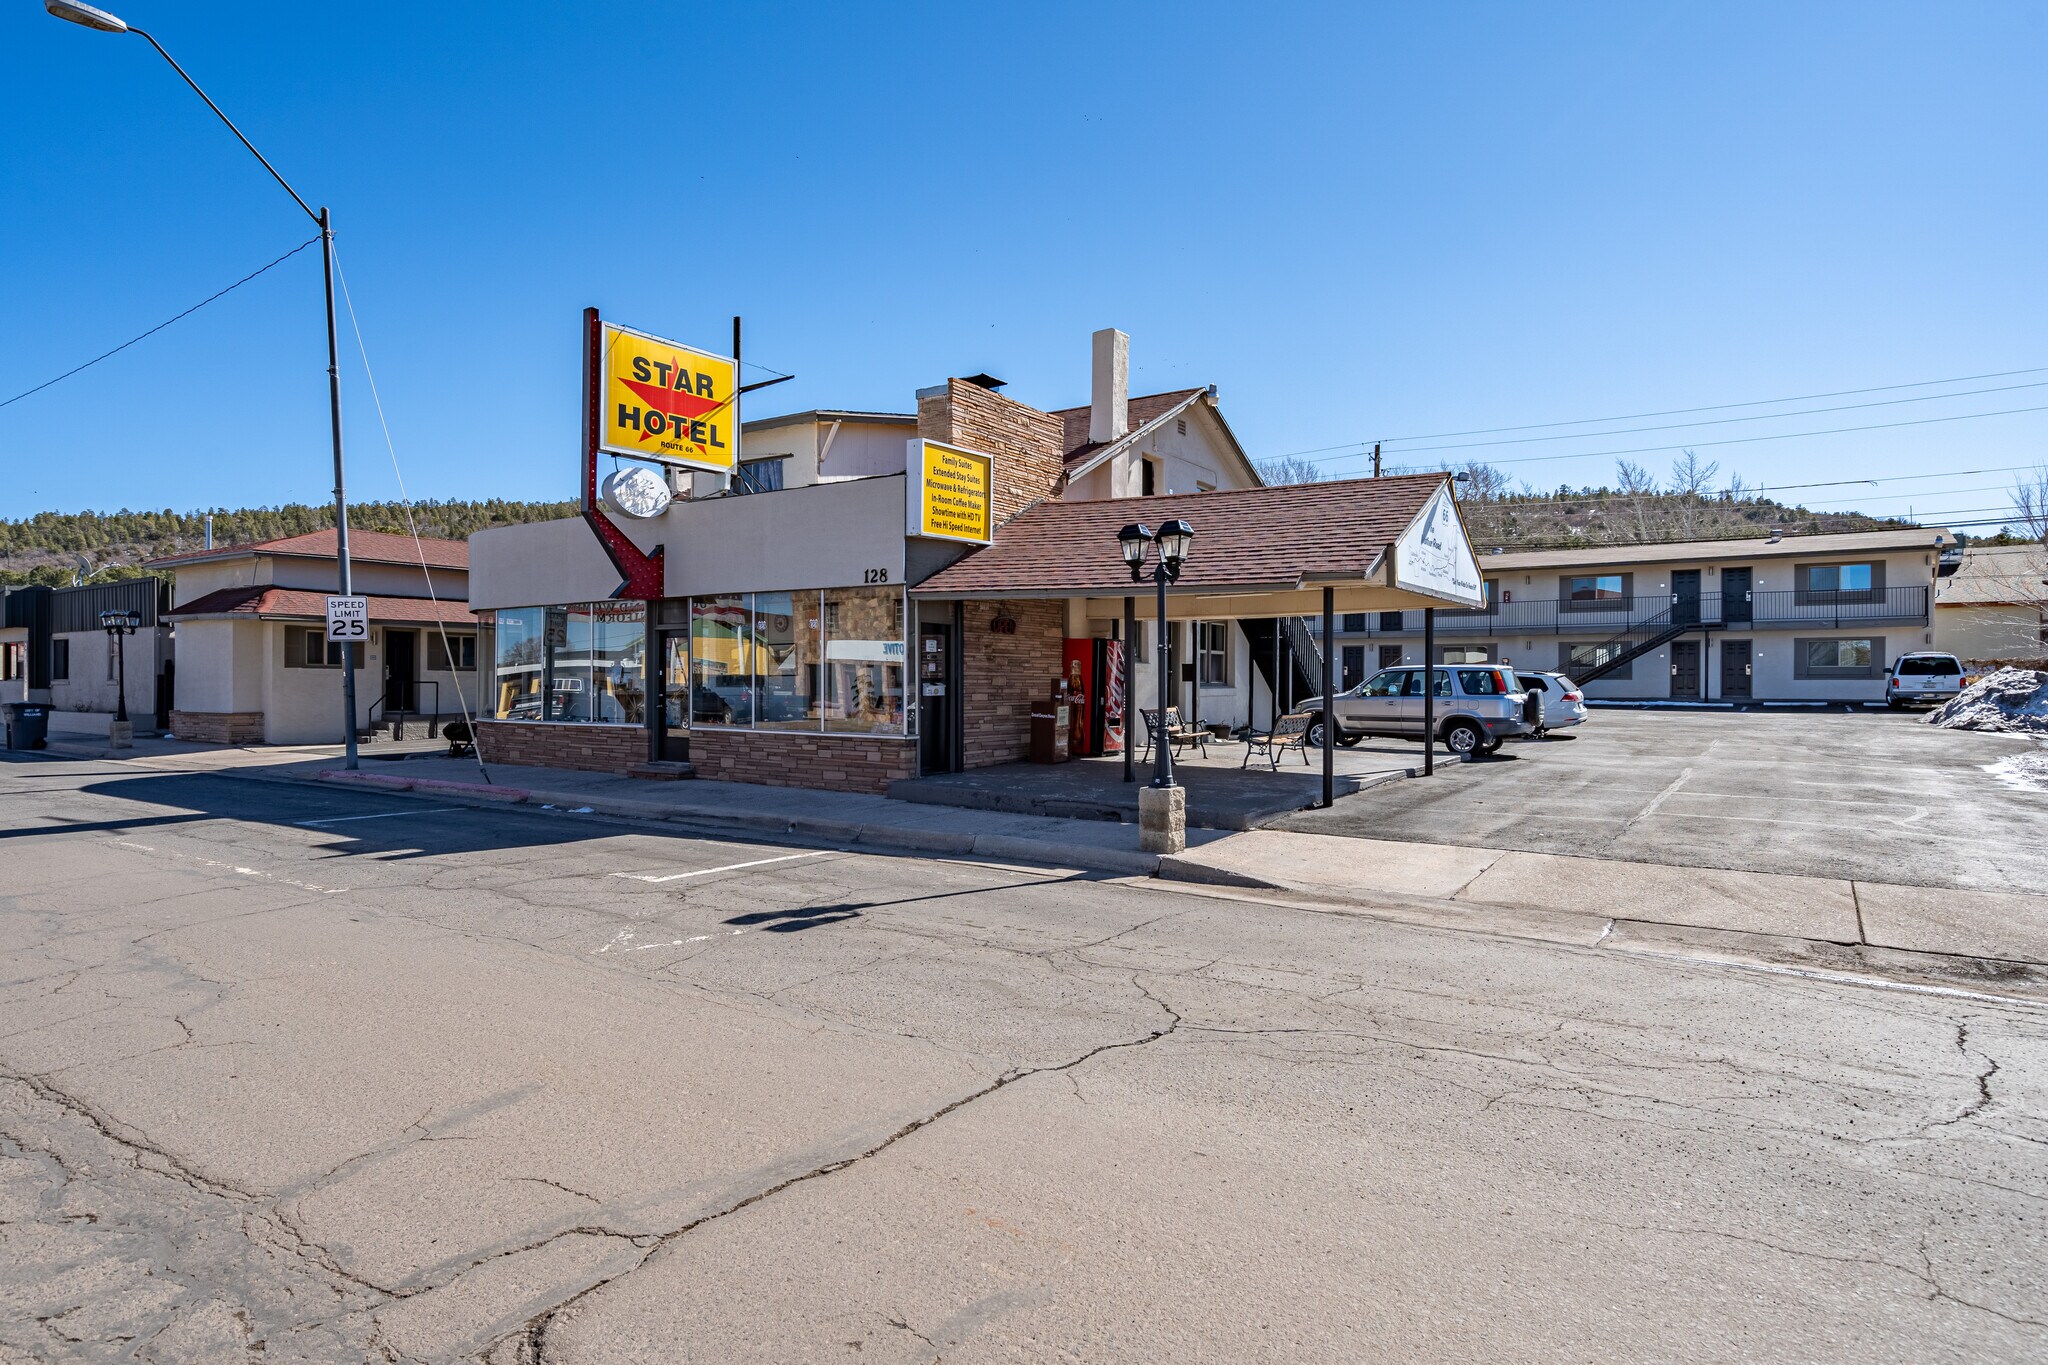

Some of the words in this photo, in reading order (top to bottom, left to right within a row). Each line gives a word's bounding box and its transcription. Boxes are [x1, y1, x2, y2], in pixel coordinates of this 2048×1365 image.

[632, 356, 713, 399] STAR
[618, 403, 725, 449] HOTEL
[660, 441, 684, 452] ROUTE
[685, 444, 694, 453] 66
[942, 455, 957, 469] Family
[958, 458, 972, 469] Suites
[933, 467, 956, 479] Extended
[956, 472, 966, 483] Stay
[967, 474, 980, 484] Suites
[926, 479, 952, 491] Microwave
[952, 484, 957, 493] &
[957, 484, 986, 499] Refrigerators
[931, 494, 952, 504] In-Room
[952, 497, 968, 507] Coffee
[968, 500, 981, 510] Maker
[932, 505, 956, 518] Showtime
[956, 510, 967, 519] with
[967, 512, 975, 521] HD
[975, 513, 981, 523] TV
[931, 519, 942, 528] Free
[943, 521, 949, 529] Hi
[948, 521, 963, 532] Speed
[963, 524, 981, 534] Internet
[864, 568, 888, 583] 128
[332, 620, 364, 636] 25
